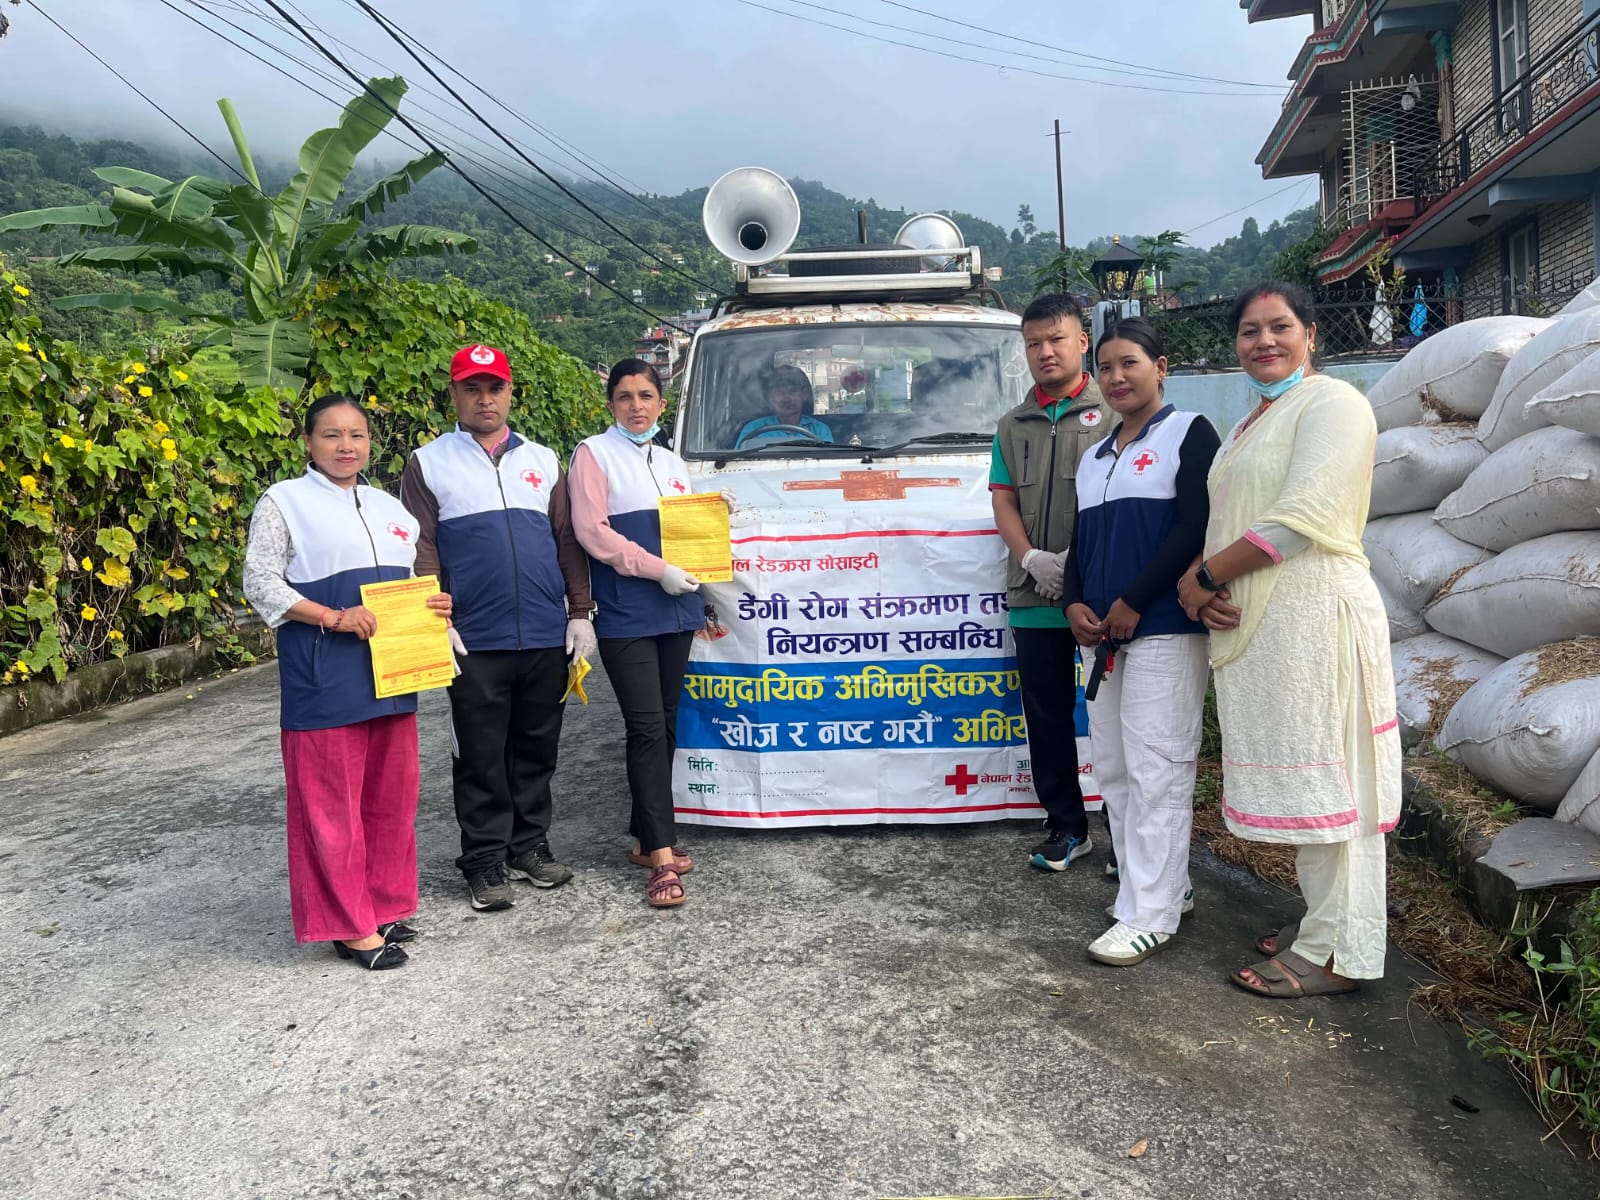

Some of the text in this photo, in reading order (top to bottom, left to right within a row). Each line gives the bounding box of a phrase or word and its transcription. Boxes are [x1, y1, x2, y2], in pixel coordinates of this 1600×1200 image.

[756, 555, 811, 572] रेडक्रस
[816, 552, 879, 572] सोसाइटी
[799, 592, 849, 620] रोग
[859, 593, 970, 619] संक्रमण
[767, 621, 1005, 655] नियन्त्रण सम्बन्धि
[683, 668, 826, 708] सामुदायिक
[788, 721, 809, 748] र
[817, 720, 875, 745] नष्ट
[980, 773, 1012, 784] नेपाल
